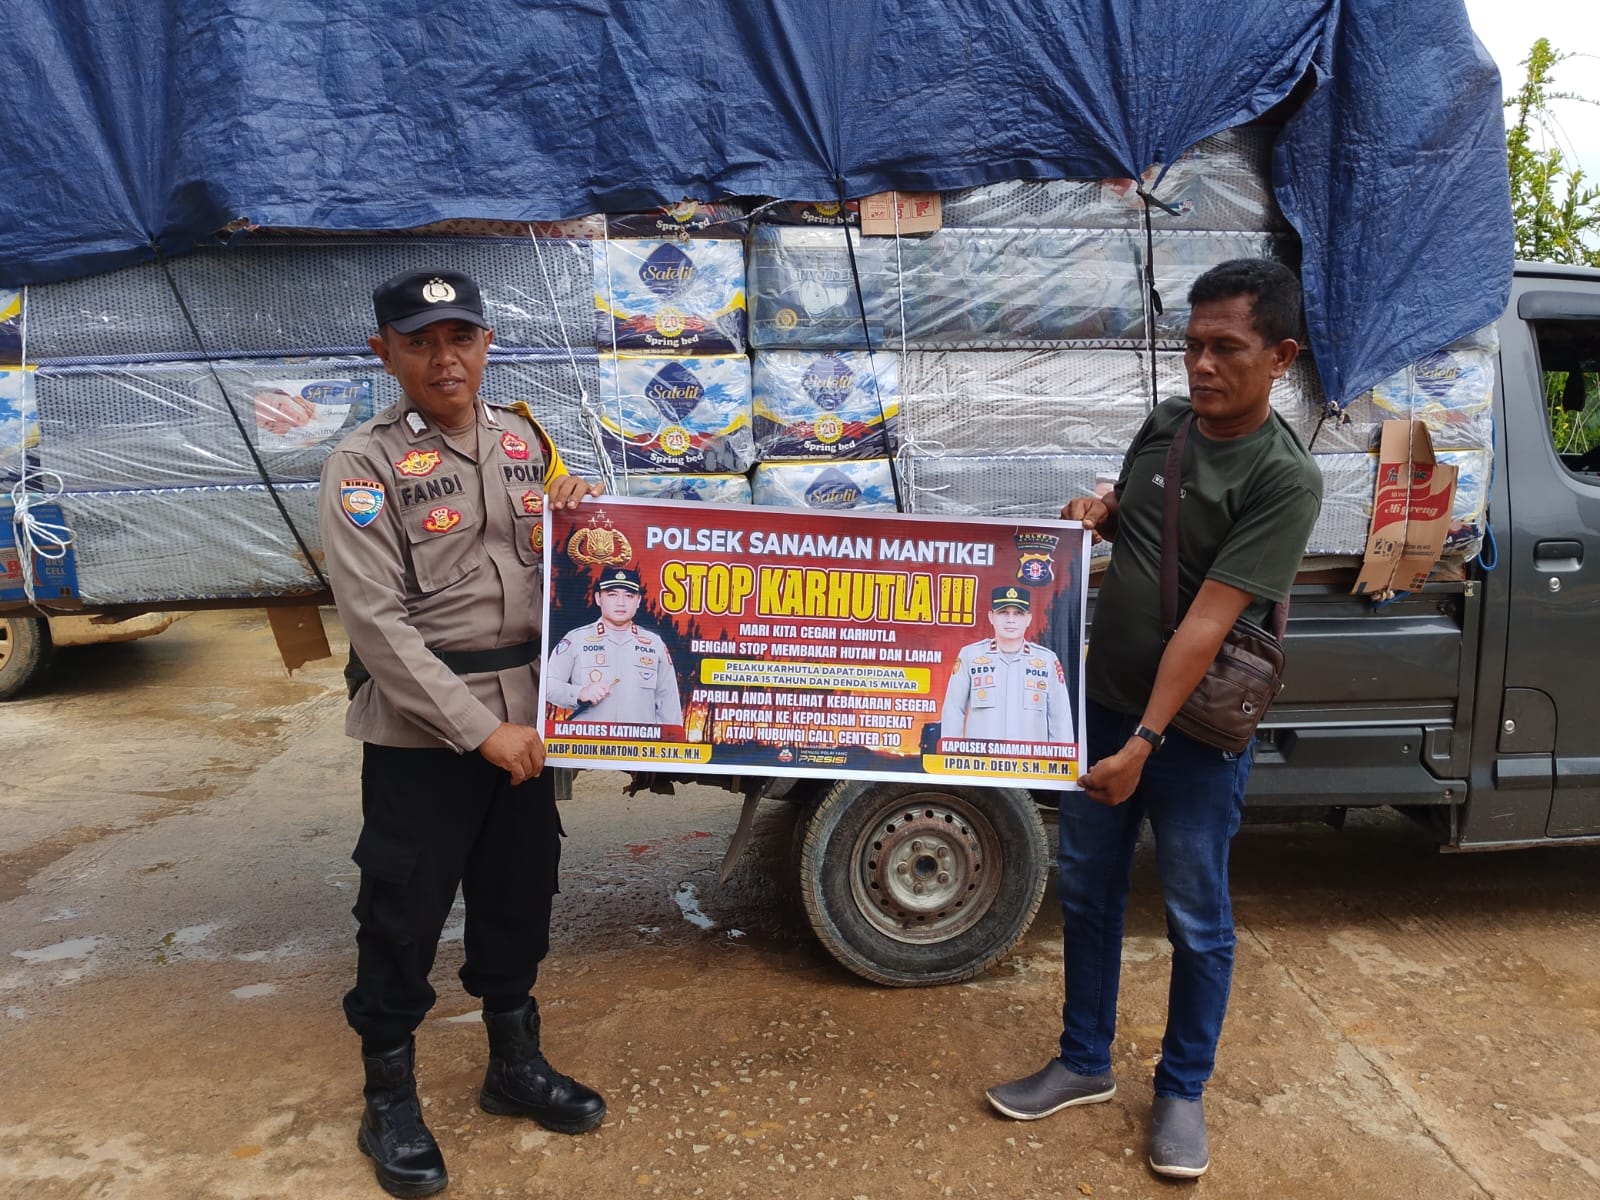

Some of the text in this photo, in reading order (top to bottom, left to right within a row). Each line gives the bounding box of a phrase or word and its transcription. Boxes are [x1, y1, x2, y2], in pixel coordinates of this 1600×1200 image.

[801, 211, 856, 225] Spring bd
[642, 265, 694, 281] Satelit
[663, 316, 678, 328] 20
[645, 334, 699, 348] Spring bed
[648, 384, 699, 400] Satelit
[822, 422, 836, 435] 20
[668, 434, 684, 445] 20
[803, 440, 856, 454] Spring bed
[649, 452, 705, 466] Spring bed
[503, 465, 544, 482] POLRI
[401, 474, 464, 506] FANDI
[807, 488, 858, 503] Satelit
[646, 526, 995, 566] POLSEK SANAMAN MANTIKEI
[662, 561, 753, 614] STOP
[758, 568, 933, 623] KARHUTLA
[739, 623, 896, 643] MARI KITA CEGAH KARHUTLA
[691, 640, 942, 664] DENGAN STOP MEMBAKAR HUTAN DAN LAHAN
[726, 662, 904, 679] PELAKU KARHUTLA DAPAT DIPIDANA
[971, 666, 1049, 678] DEDY POLRI
[713, 673, 917, 690] PENJARA 15 TAHUN DAN DENDA 15 MILYAR
[692, 689, 936, 713] APABILA ANDA MELIHAT KEBAKARAN SEGERA
[714, 708, 913, 730] LAPORKAN KE KEPOLISIAN TERDEKAT
[554, 723, 661, 739] KAPOLRES KATINGAN
[725, 726, 900, 747] ATAU HUBUNGI CALL CENTER 110
[547, 743, 570, 755] AKBP
[571, 744, 599, 756] DODIK
[684, 749, 702, 760] M.H.
[941, 740, 1076, 758] KAPOLSEK SANAMAN MANTIKEI
[799, 755, 848, 764] PRESISI
[944, 757, 970, 770] IPDA
[973, 758, 989, 771] Dr.
[1048, 762, 1072, 775] M.H.
